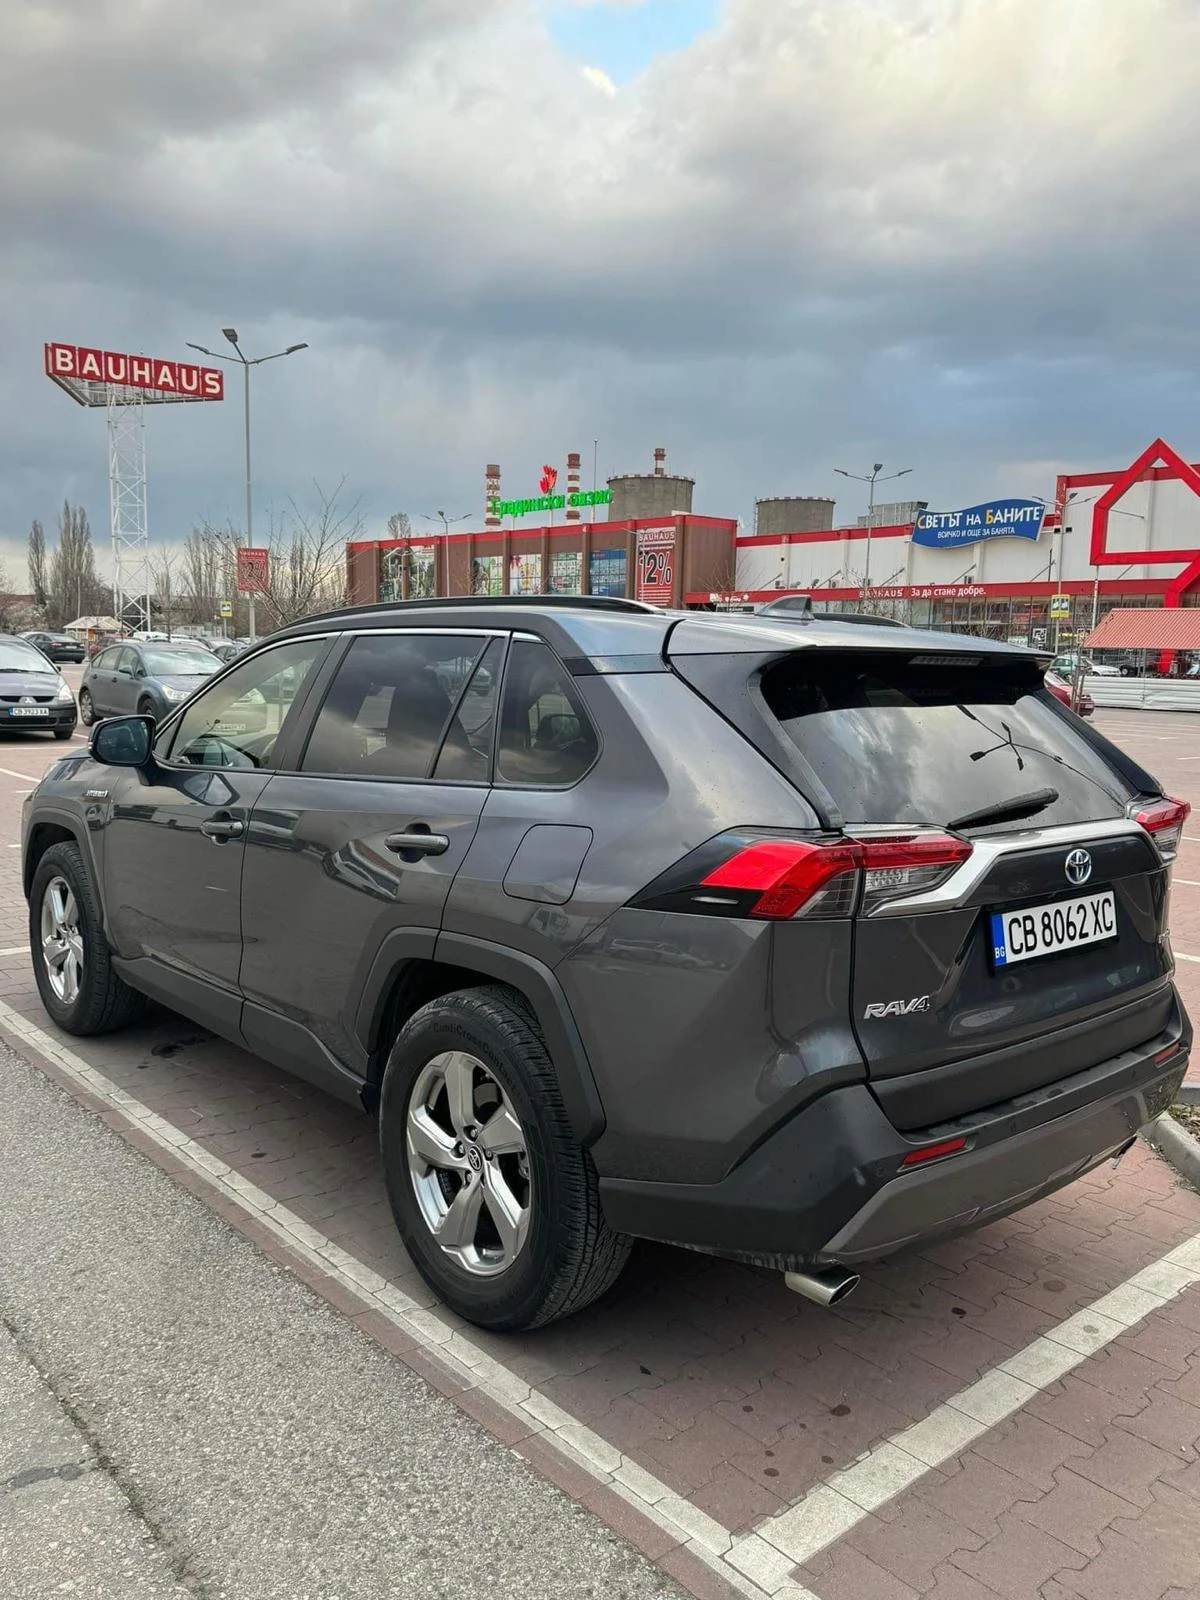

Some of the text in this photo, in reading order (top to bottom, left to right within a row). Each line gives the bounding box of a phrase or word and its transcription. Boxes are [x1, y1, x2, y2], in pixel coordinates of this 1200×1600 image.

[55, 348, 221, 394] BAUHAUS
[917, 506, 1041, 529] СВЕТЪТ НА БАНИТЕ
[937, 530, 961, 539] ВСИЧКО
[967, 528, 981, 538] ОЩЕ
[982, 528, 990, 536] ЗА
[991, 527, 1016, 535] БАНЯТА
[911, 586, 986, 598] За да стане добре.
[995, 946, 1006, 959] BG
[1041, 903, 1089, 947] 8062
[864, 995, 930, 1019] RAV4
